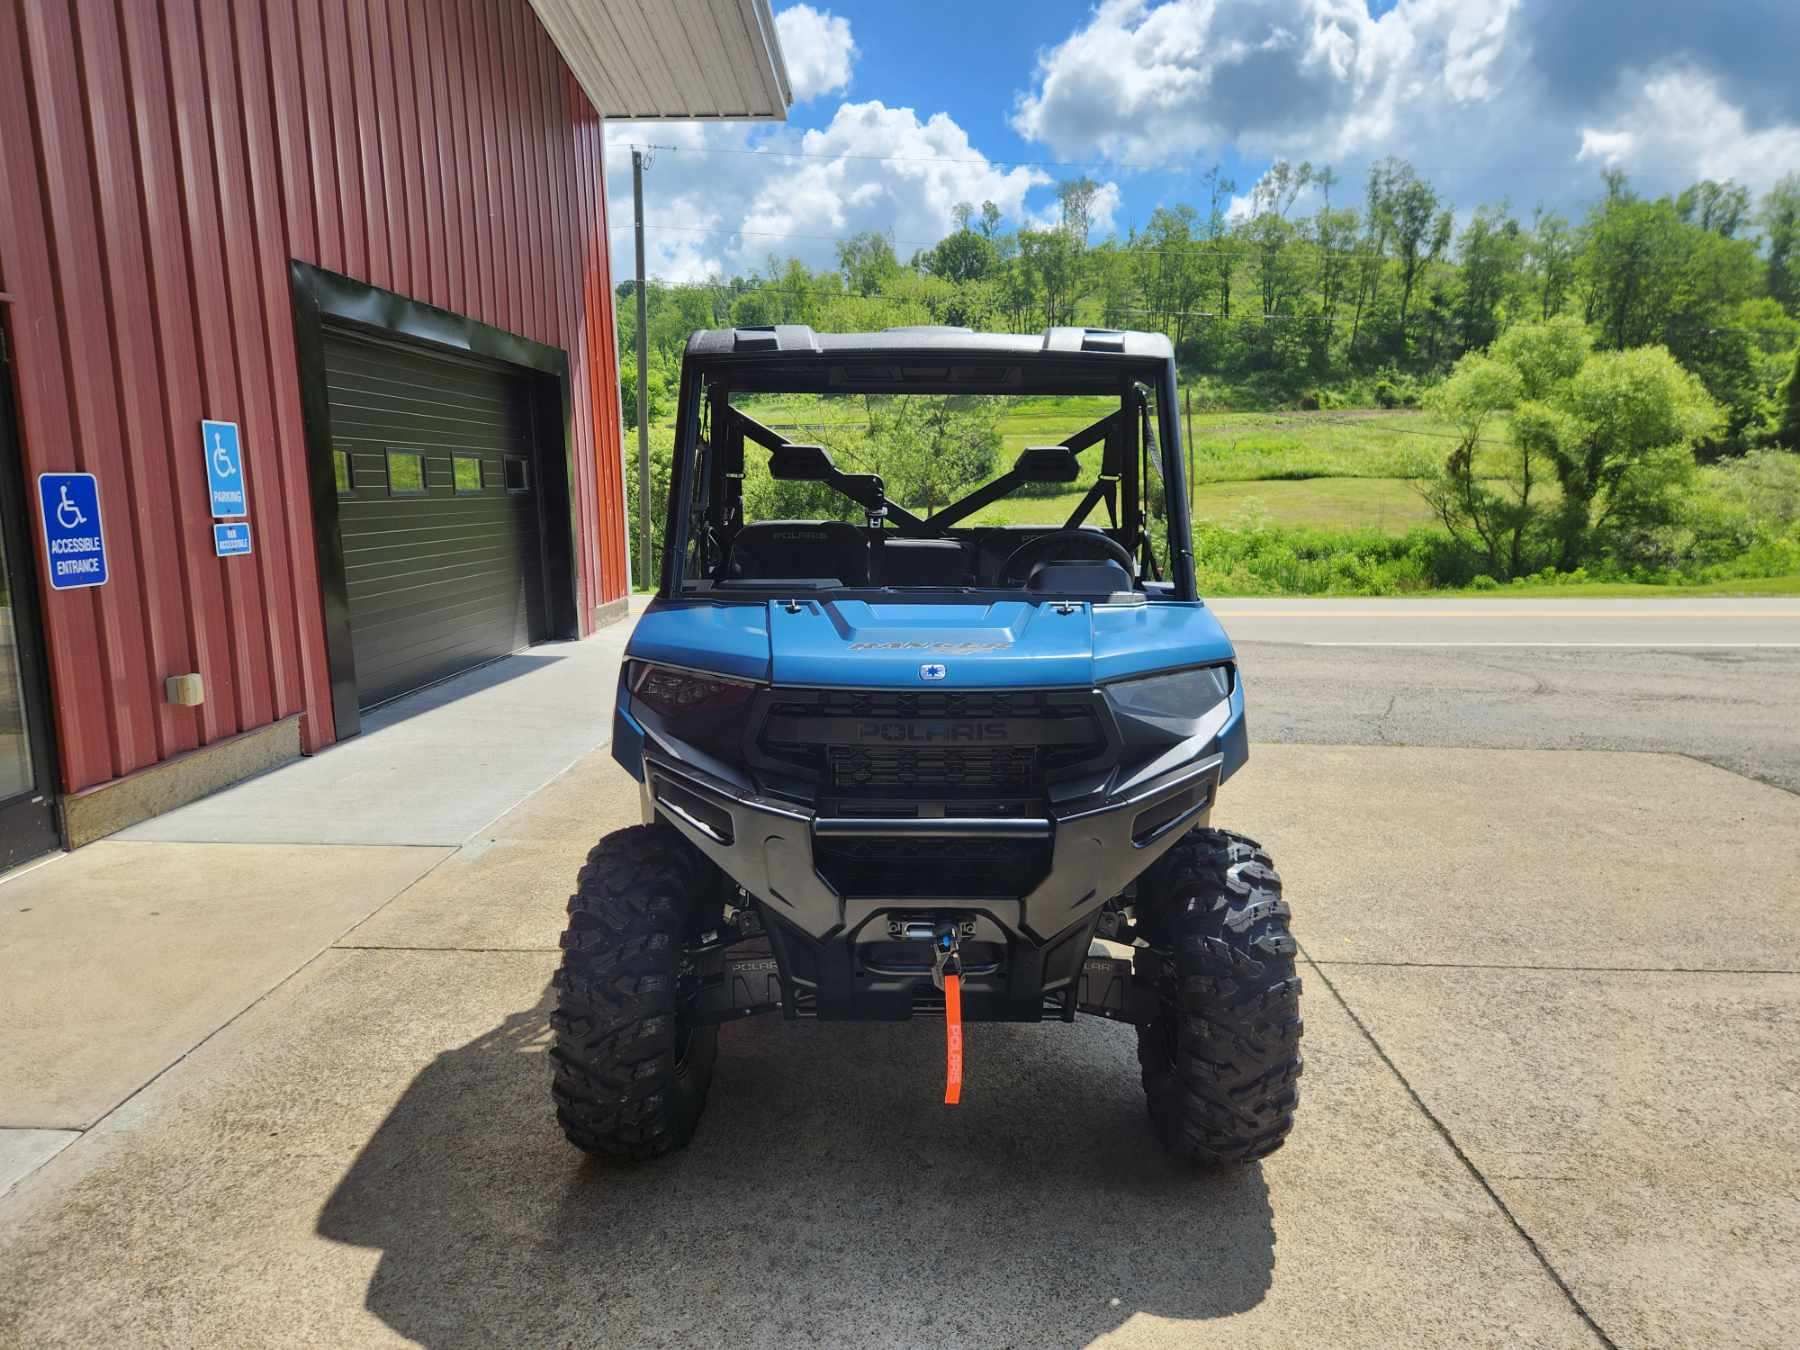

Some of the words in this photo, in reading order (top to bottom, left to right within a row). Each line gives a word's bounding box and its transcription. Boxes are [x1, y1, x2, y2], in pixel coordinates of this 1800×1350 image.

[214, 490, 242, 503] PARKING
[51, 537, 101, 554] ACCESSIBLE
[57, 558, 100, 575] ENTRANCE
[857, 721, 1007, 742] POLARIS
[733, 961, 778, 971] POLAR
[948, 1024, 961, 1084] POLARIS
